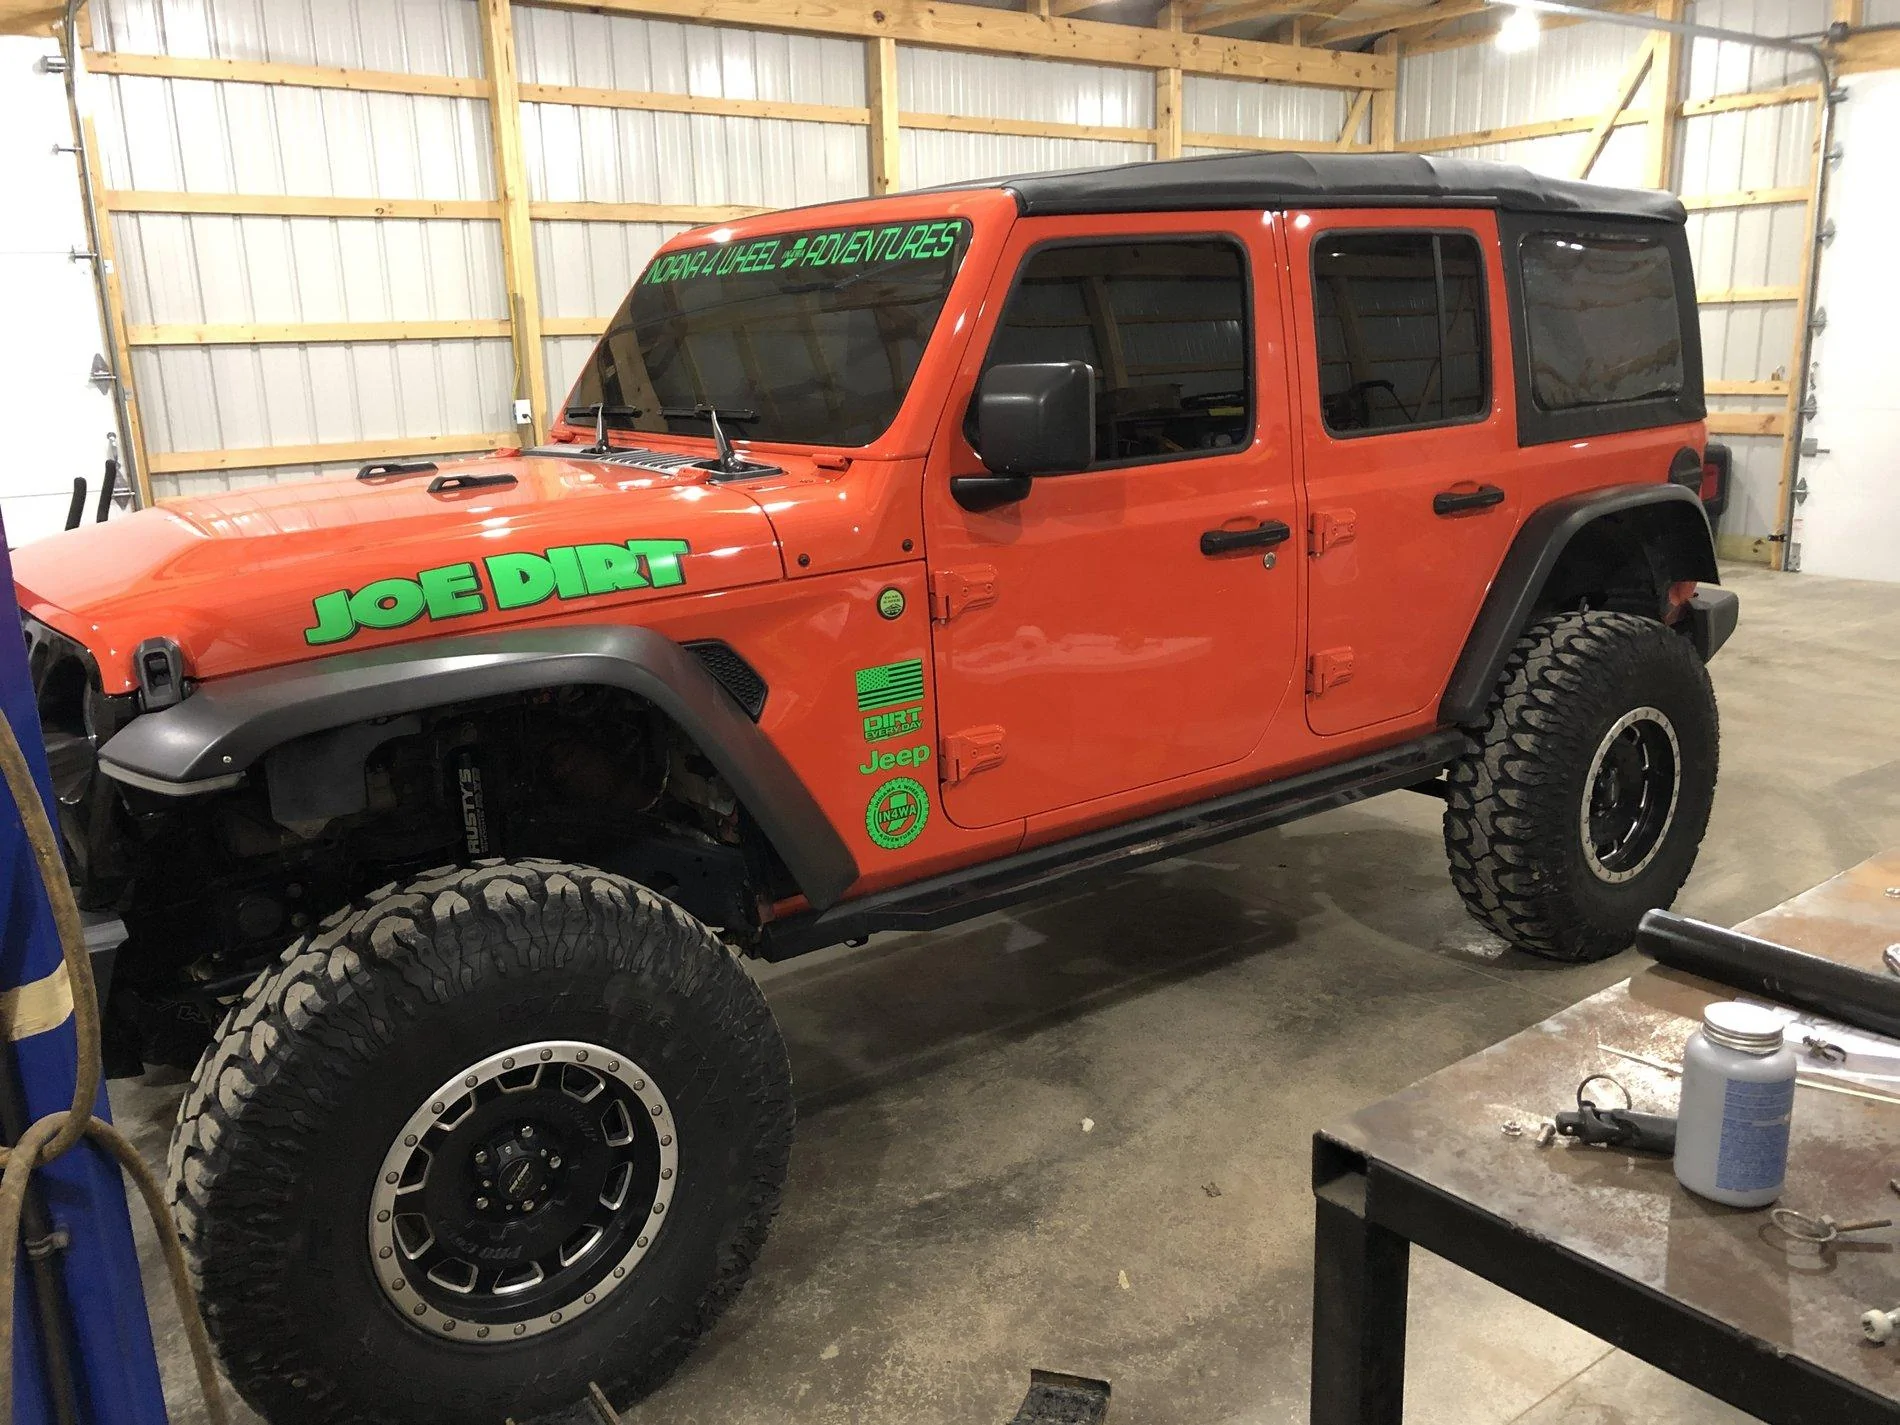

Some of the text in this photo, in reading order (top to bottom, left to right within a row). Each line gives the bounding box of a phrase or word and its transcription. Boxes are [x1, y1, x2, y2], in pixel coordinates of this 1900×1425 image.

[701, 247, 723, 277] 4
[716, 240, 780, 275] WHEEL
[800, 221, 962, 267] ADVENTURES
[304, 538, 691, 645] JOE DIRT
[863, 706, 923, 733] DIRT
[865, 720, 924, 739] EVERY DAY
[859, 745, 931, 775] Jeep
[879, 805, 917, 823] IN4WA
